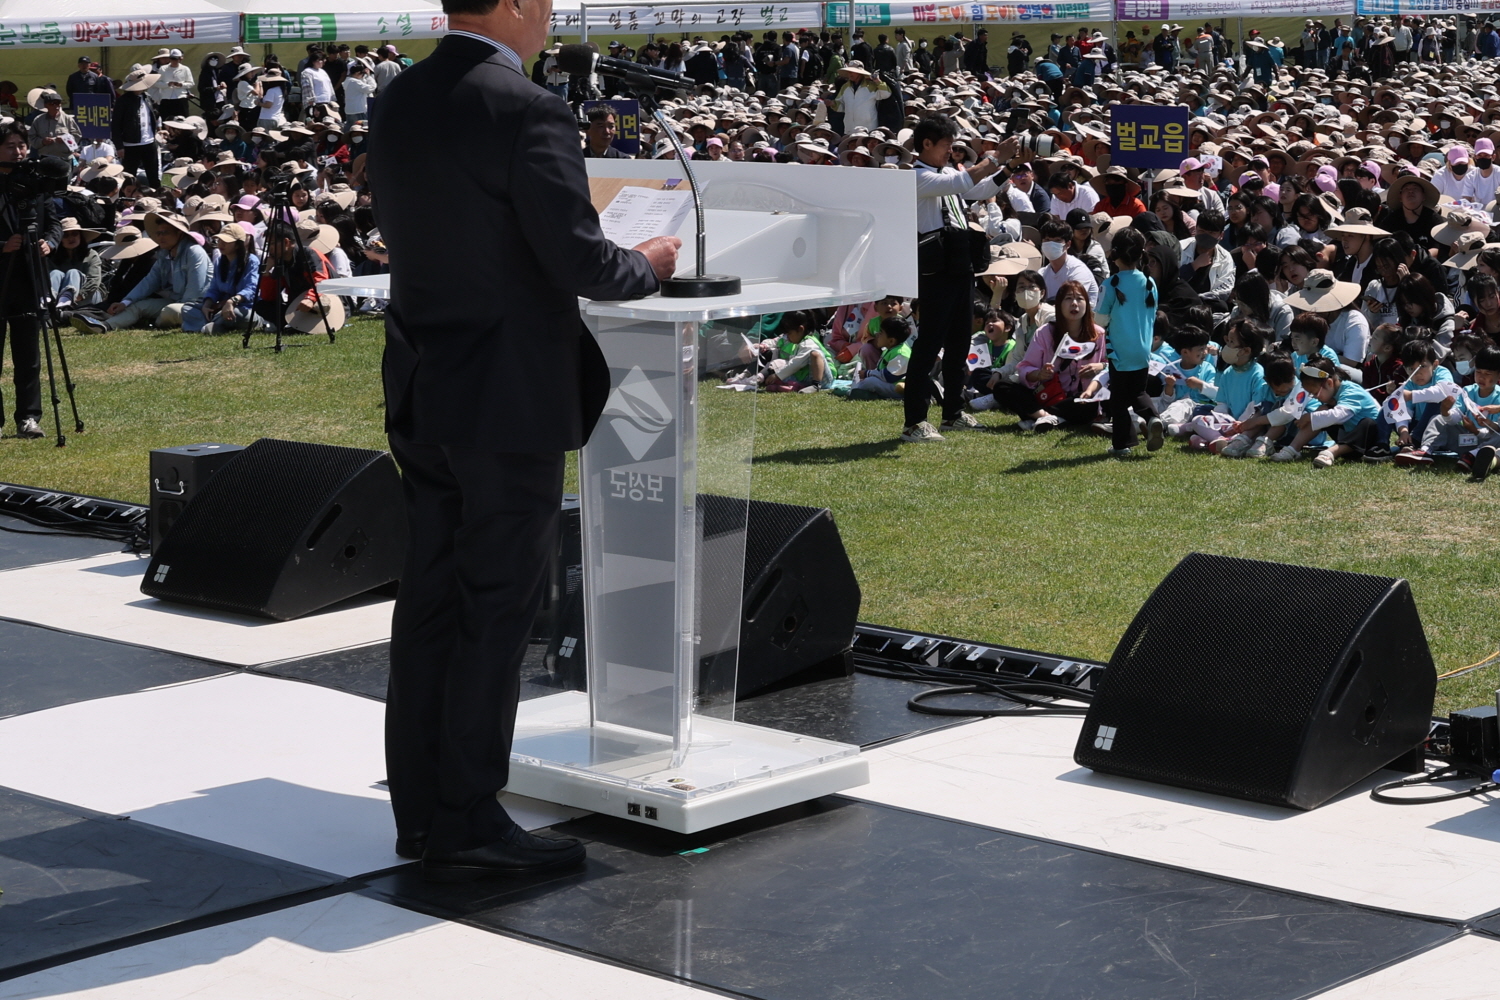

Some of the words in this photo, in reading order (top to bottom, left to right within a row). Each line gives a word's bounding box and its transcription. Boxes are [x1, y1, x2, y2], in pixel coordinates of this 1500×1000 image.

[608, 9, 640, 31] 일품
[716, 7, 745, 26] 고장
[760, 5, 789, 26] 벌교
[835, 4, 882, 24] 미력면
[971, 4, 984, 21] 힘
[1017, 3, 1054, 20] 행복한
[1055, 2, 1090, 19] 미력면
[1124, 0, 1162, 18] 득량면
[20, 21, 67, 46] 노동,
[72, 20, 110, 43] 아주
[257, 15, 323, 40] 벌교읍
[376, 12, 413, 37] 소설
[76, 105, 109, 127] 복내면
[1116, 121, 1185, 153] 벌교읍
